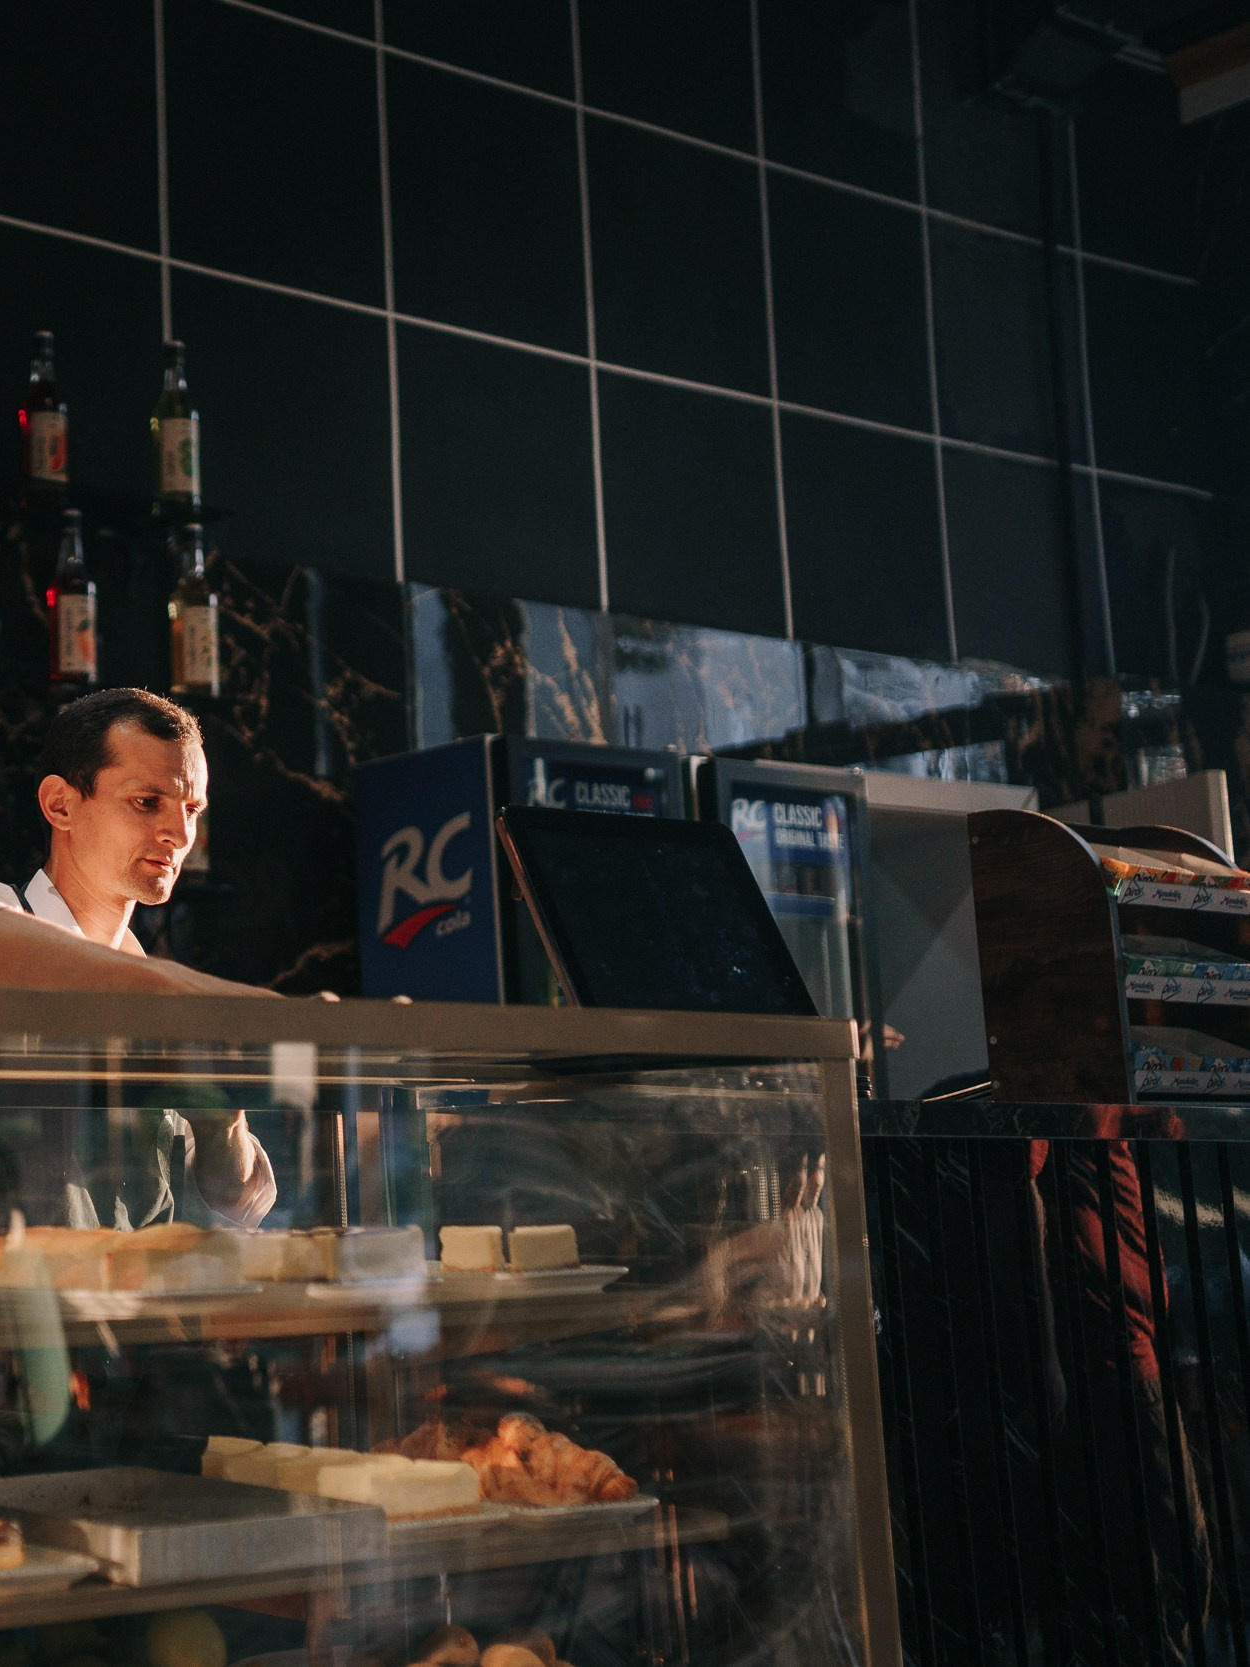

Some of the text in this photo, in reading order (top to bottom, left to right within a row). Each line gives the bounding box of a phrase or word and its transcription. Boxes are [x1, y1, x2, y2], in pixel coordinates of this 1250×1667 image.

[575, 781, 631, 810] CLASSIC
[732, 798, 767, 833] RC
[773, 802, 823, 829] CLASSIC
[377, 811, 473, 935] RC
[435, 910, 471, 937] cola
